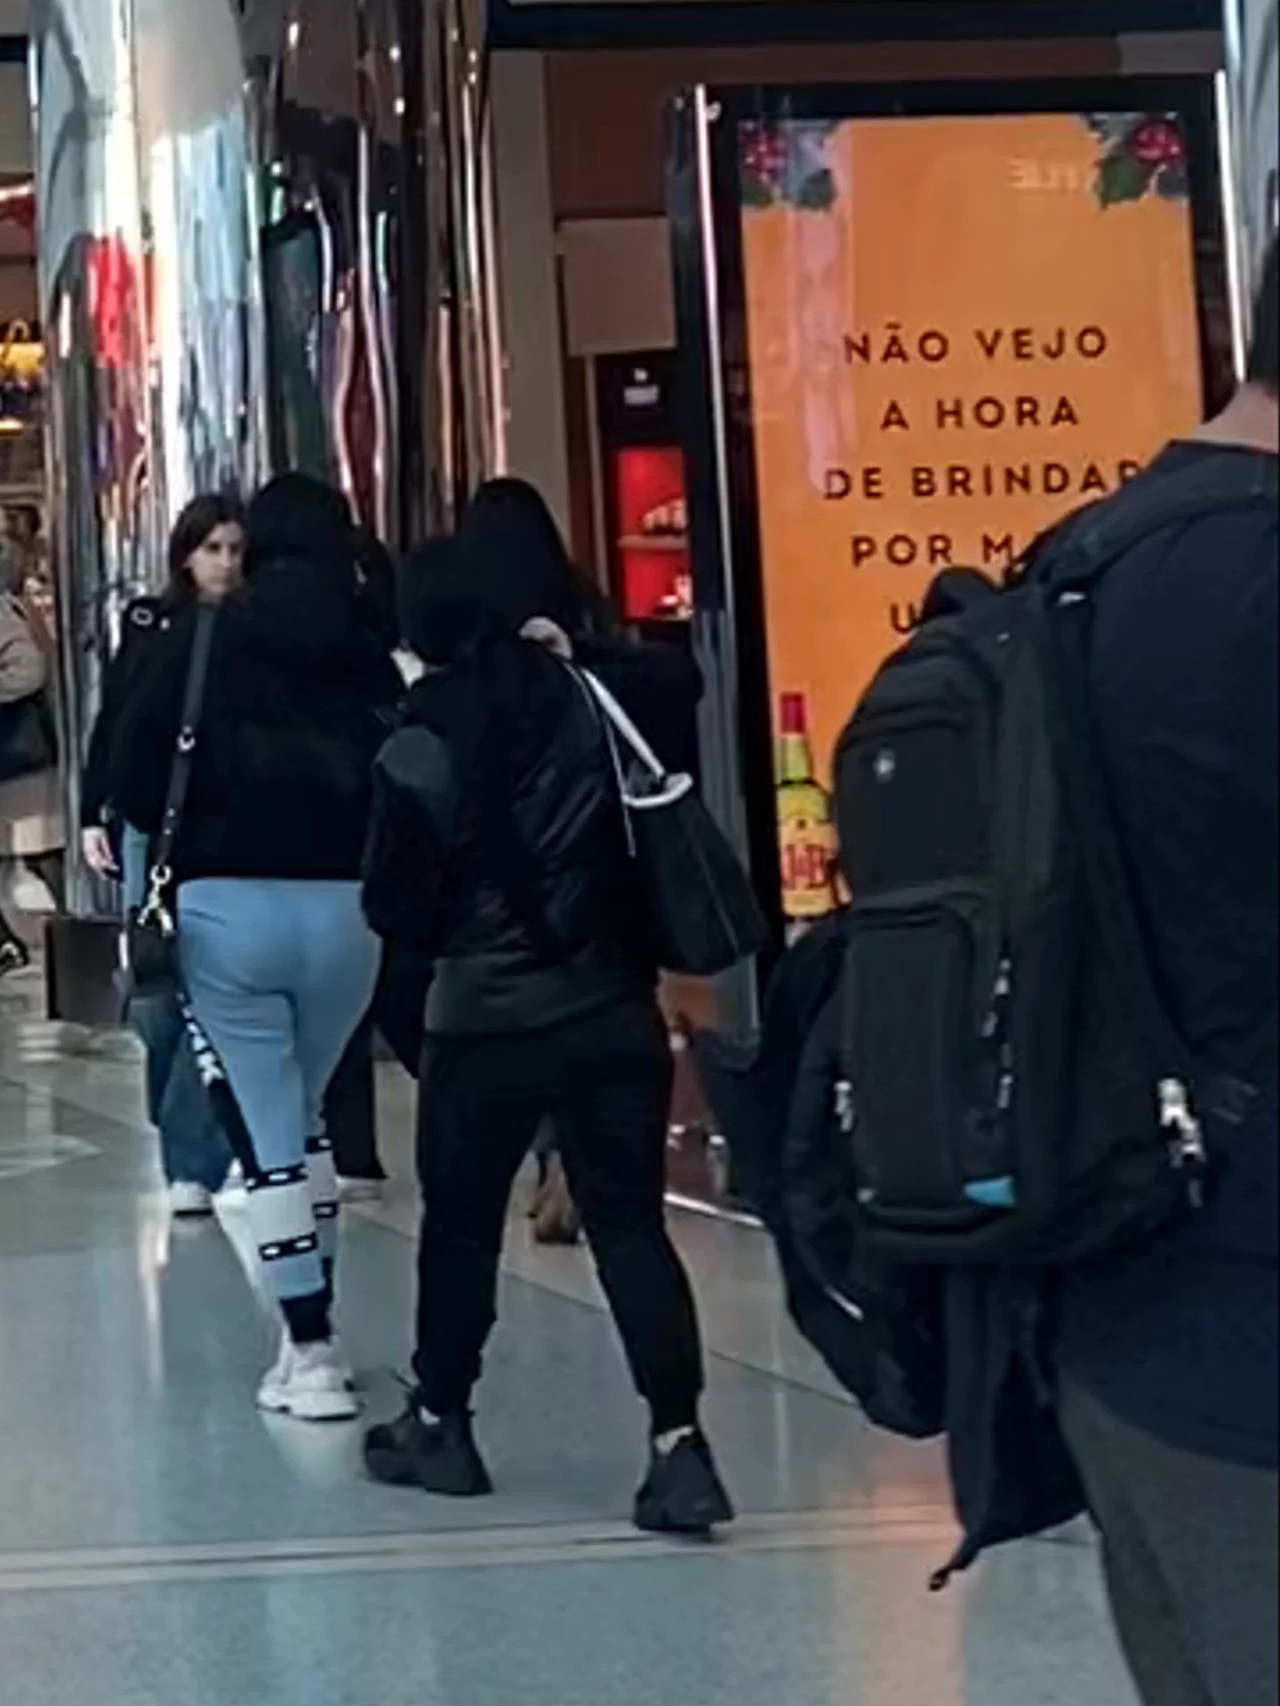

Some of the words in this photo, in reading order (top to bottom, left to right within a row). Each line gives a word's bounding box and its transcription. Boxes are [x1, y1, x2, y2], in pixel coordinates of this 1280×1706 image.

[843, 323, 949, 365] NÃO
[974, 326, 1107, 361] VEJO
[880, 399, 909, 430] A
[936, 394, 1080, 429] HORA
[823, 466, 884, 500] DE
[851, 534, 954, 568] POR
